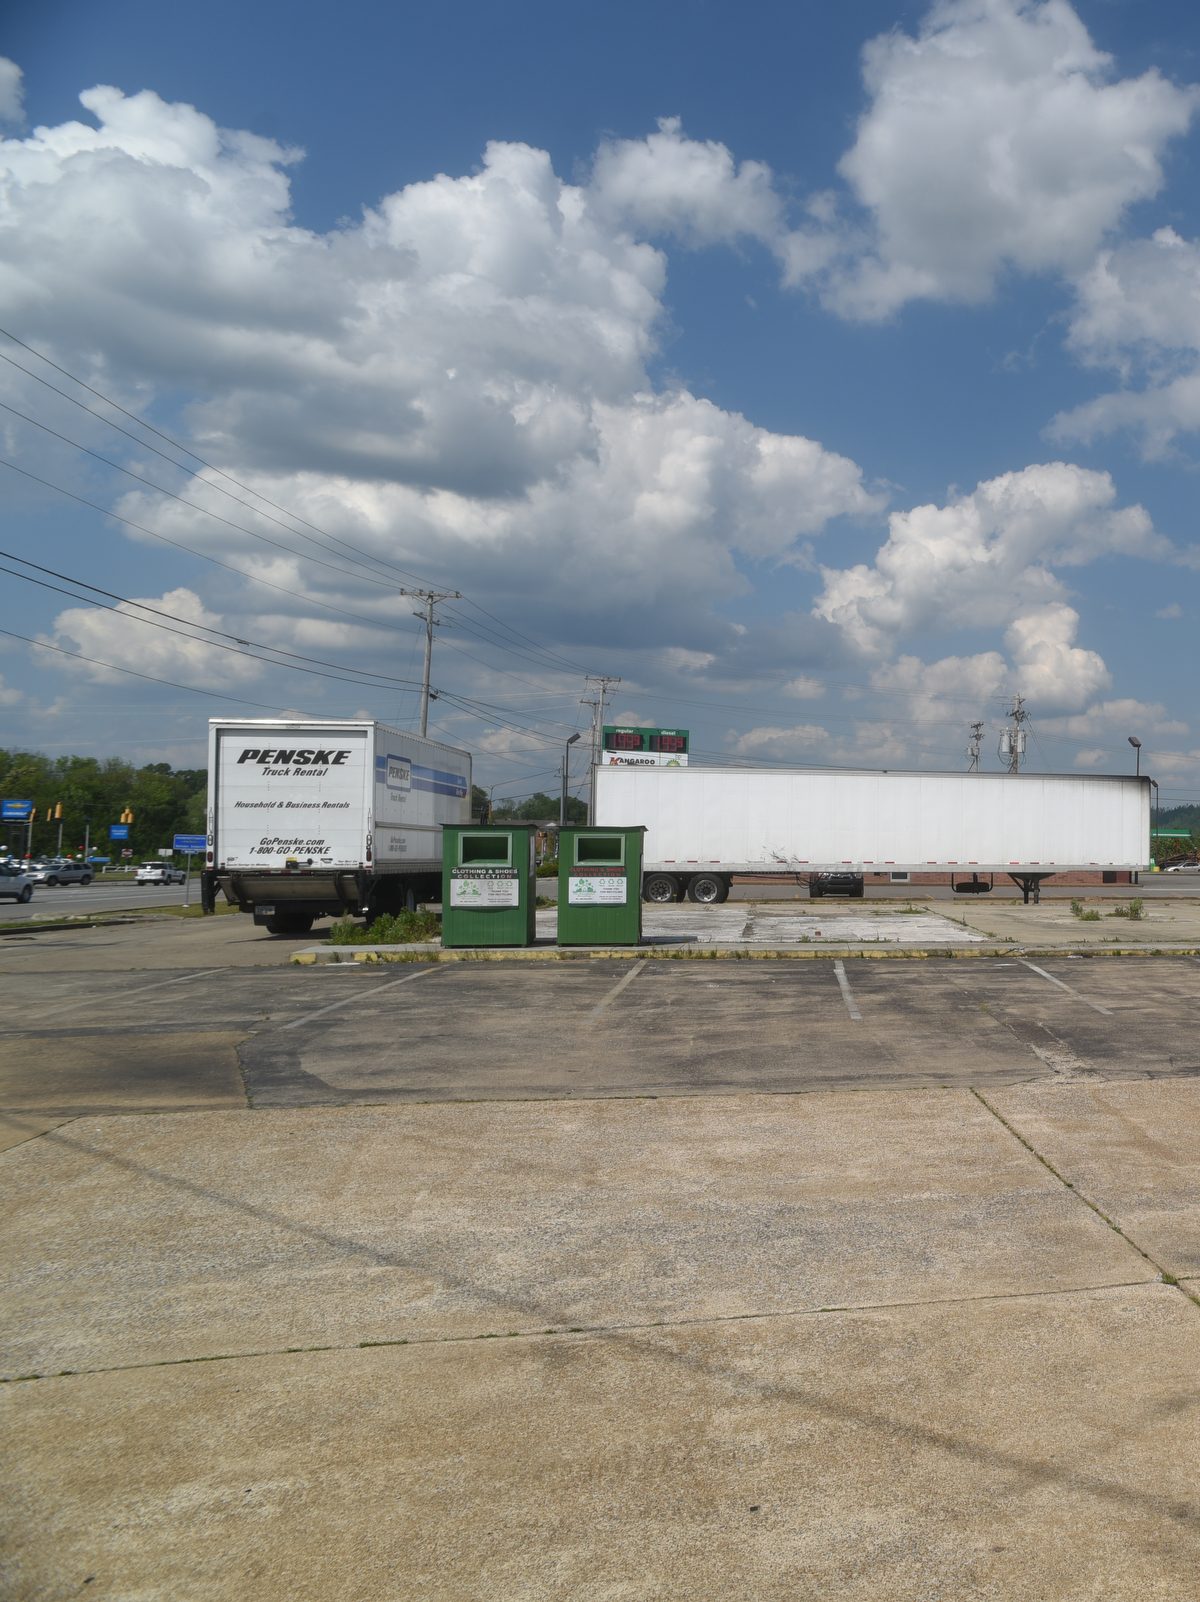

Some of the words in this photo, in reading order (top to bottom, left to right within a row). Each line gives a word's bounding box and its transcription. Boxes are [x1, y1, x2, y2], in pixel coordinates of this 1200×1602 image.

[236, 749, 352, 765] PENSKE
[609, 756, 656, 765] KANGAROO
[262, 767, 291, 776] Truck
[292, 767, 329, 777] Rental
[388, 765, 410, 781] PENSKE
[234, 801, 276, 809] Household
[277, 801, 284, 809] &
[285, 801, 321, 809] Business
[321, 801, 350, 809] Rentals
[260, 837, 325, 846] GoPenske.com
[249, 846, 331, 855] 1-800-GO-PENSKE
